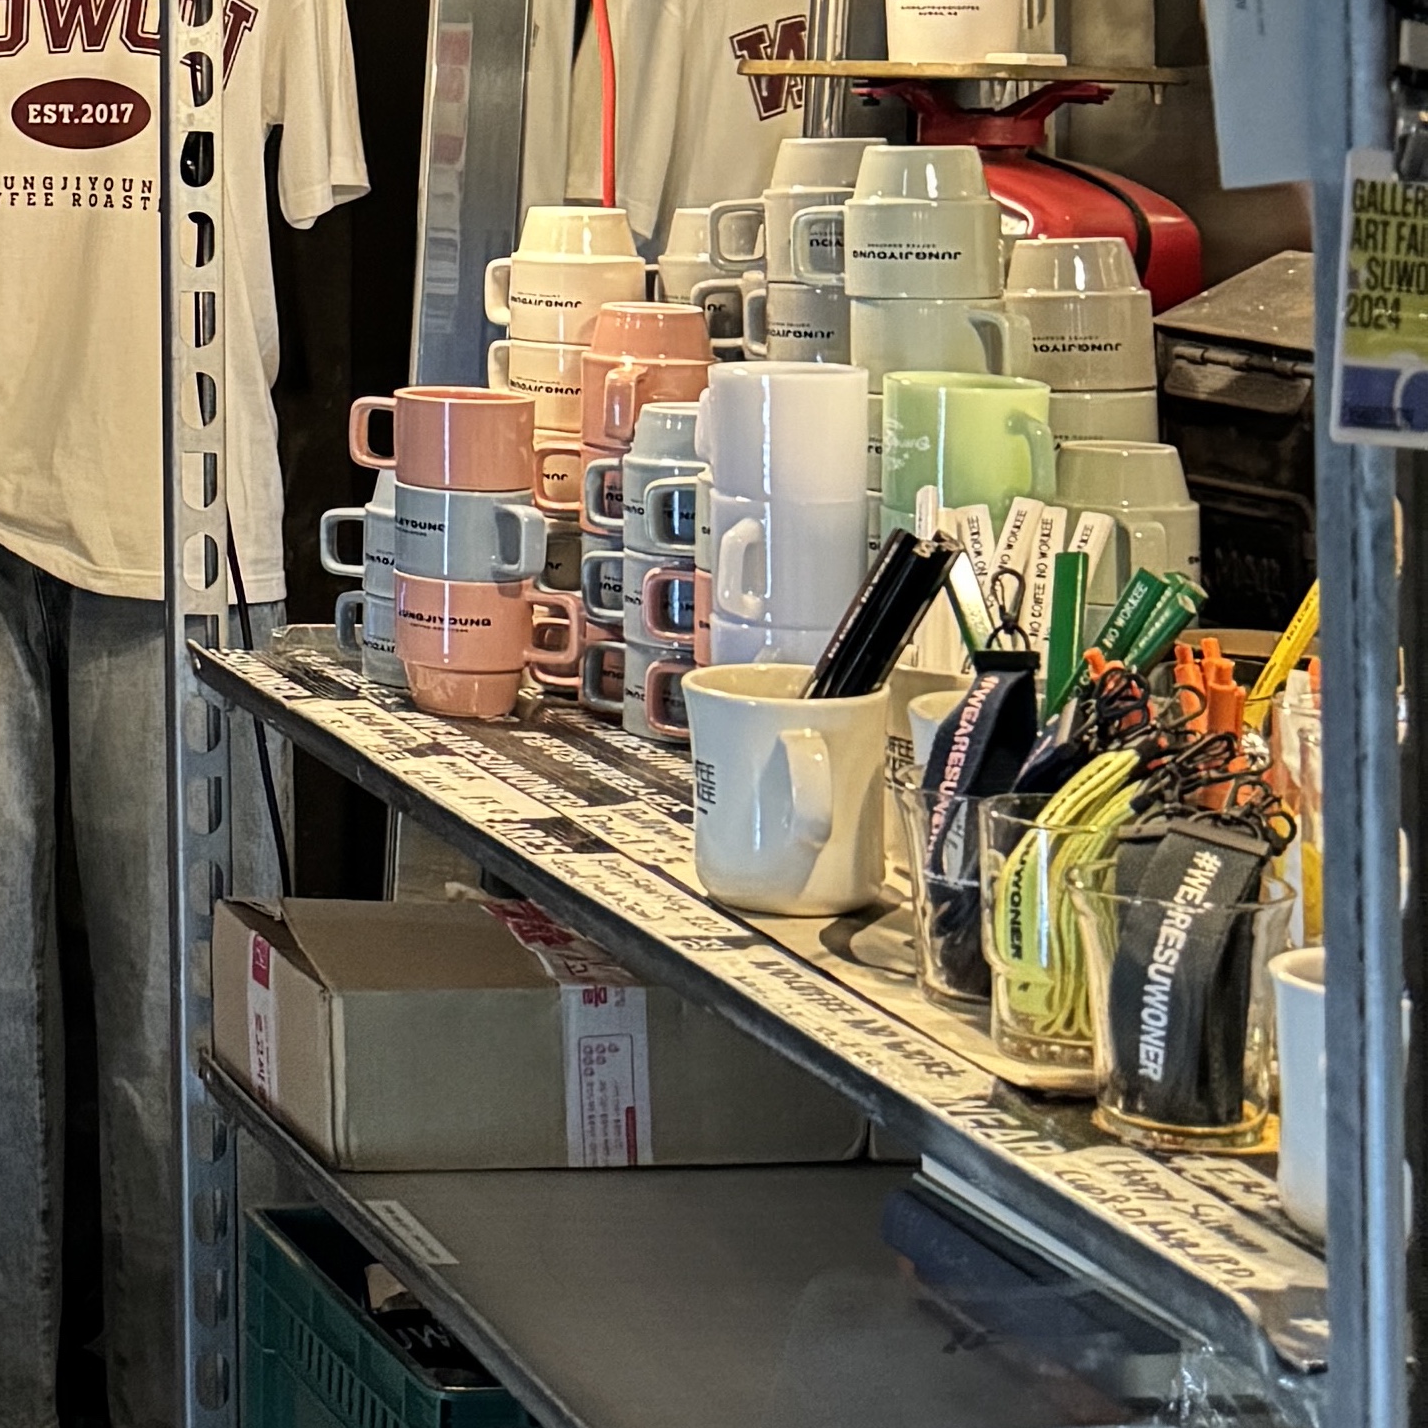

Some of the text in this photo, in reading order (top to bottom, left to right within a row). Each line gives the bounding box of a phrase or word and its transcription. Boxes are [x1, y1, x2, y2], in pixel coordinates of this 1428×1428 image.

[27, 103, 134, 125] EST.2017
[72, 192, 162, 212] ROAST
[1350, 217, 1391, 254] ART
[852, 250, 962, 261] JUNGJIYOUNG
[1346, 292, 1402, 331] 2024
[1006, 509, 1027, 550] WORKEE
[1028, 518, 1054, 638] NO COFFEE NO WORKEE
[1102, 627, 1120, 649] NO
[1114, 580, 1148, 629] WORKEE
[1137, 850, 1223, 1085] #WEARESUWONER
